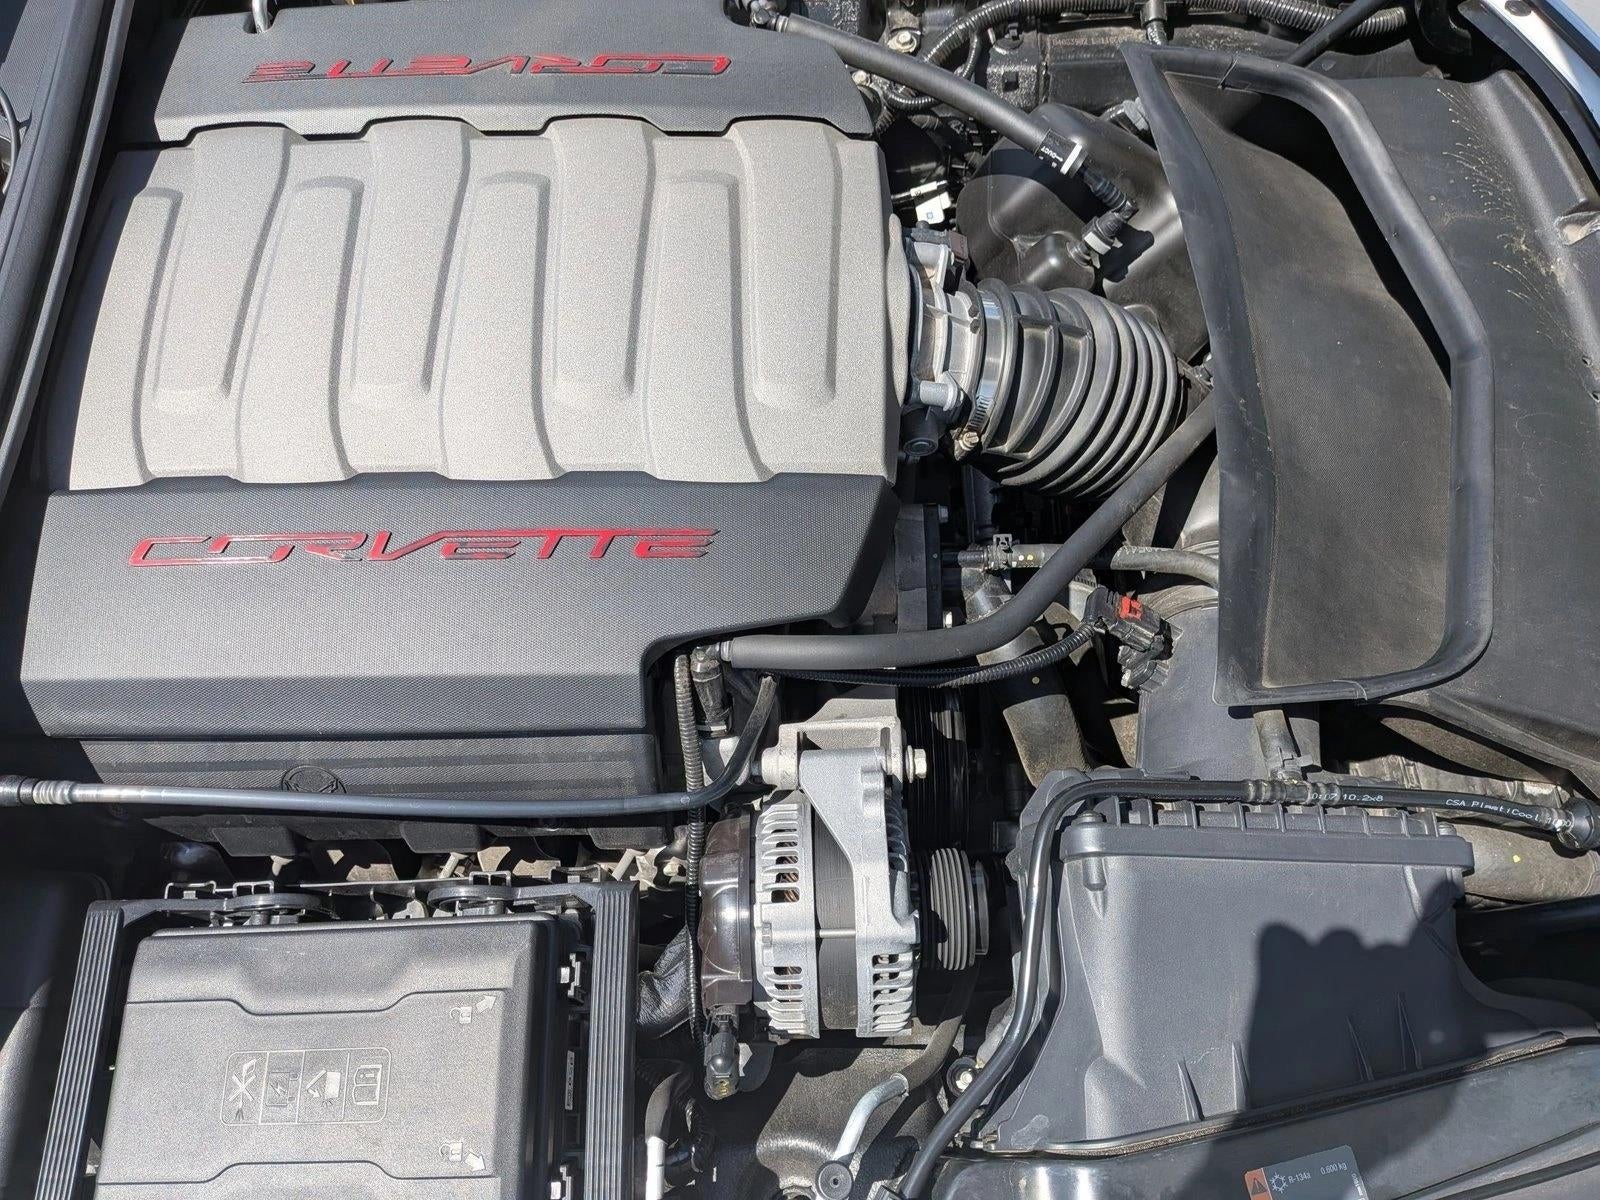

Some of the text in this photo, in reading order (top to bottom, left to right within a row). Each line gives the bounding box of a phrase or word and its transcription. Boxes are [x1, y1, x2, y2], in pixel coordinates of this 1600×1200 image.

[242, 54, 730, 83] CORVETTE
[129, 529, 720, 567] CORVETTE
[1342, 793, 1384, 802] 10.2x8
[1445, 799, 1466, 808] CSA
[1288, 1172, 1312, 1184] R-134a
[1338, 1161, 1348, 1171] kg
